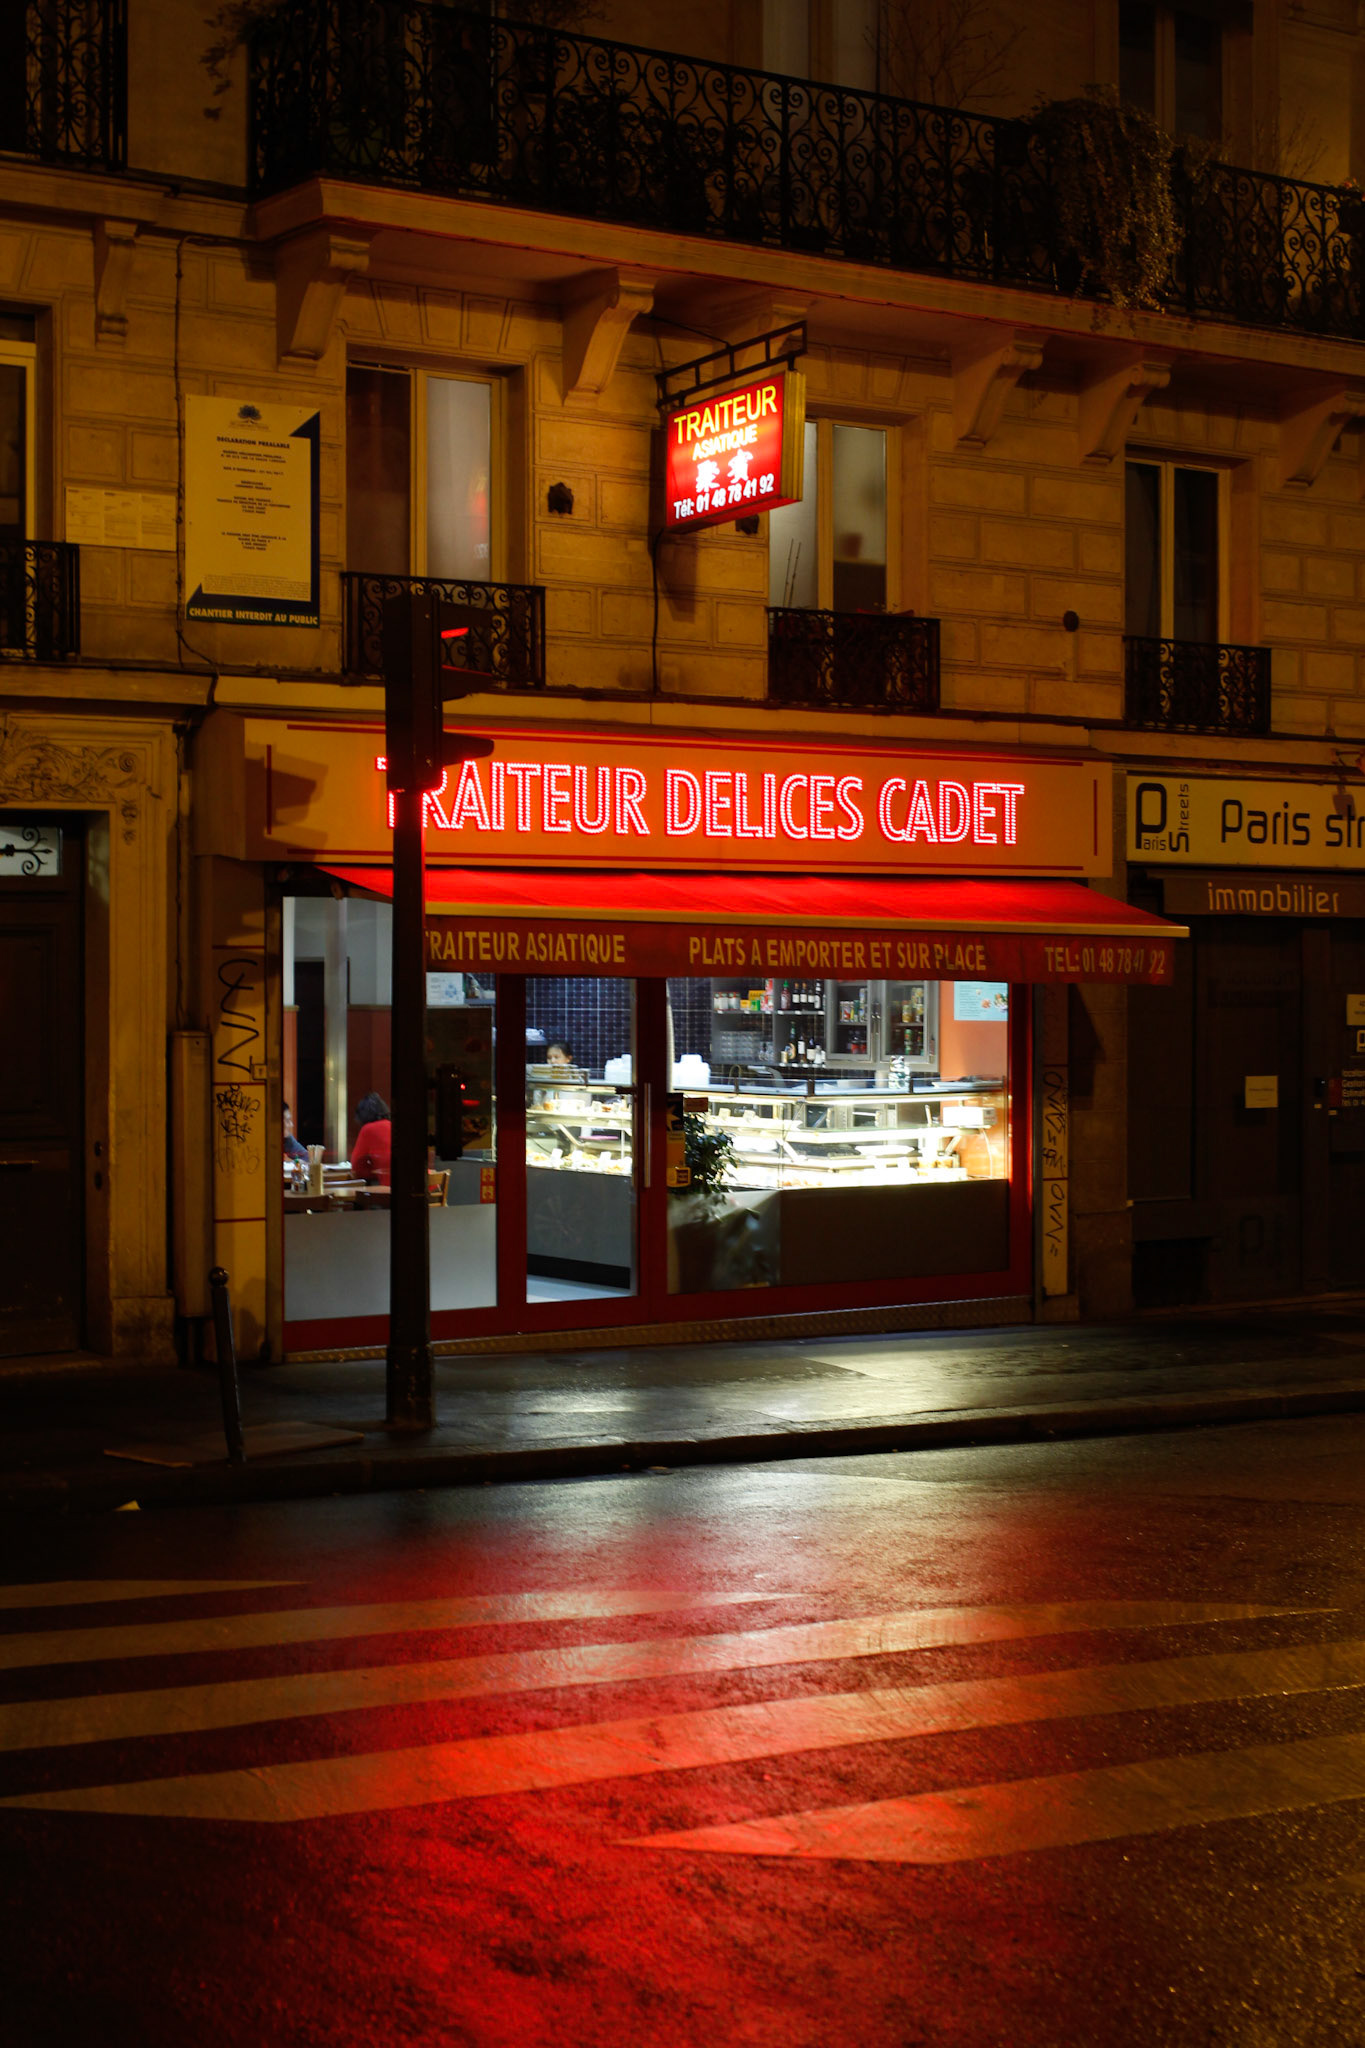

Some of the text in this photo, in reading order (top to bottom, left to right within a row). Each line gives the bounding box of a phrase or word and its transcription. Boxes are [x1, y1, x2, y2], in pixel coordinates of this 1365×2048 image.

[674, 385, 777, 444] TRAITEUR
[692, 423, 758, 461] ASIATIQUE
[696, 492, 710, 513] 01
[711, 487, 727, 508] 48
[728, 483, 742, 504] 78
[743, 478, 757, 499] 41
[759, 473, 775, 494] 92
[189, 607, 318, 625] CHANTIER INTERDIT AU PUBLIC
[665, 769, 865, 840] DELICES
[878, 777, 1025, 845] CADET
[1220, 799, 1311, 846] Paris
[1207, 881, 1340, 914] immobilier
[525, 932, 625, 963] ASIATIQUE
[689, 936, 987, 971] PLATS A EMPORTER ET SUR PLACE
[1044, 946, 1081, 973] TEL:
[1082, 947, 1096, 973] 01
[1099, 947, 1114, 973] 48
[1117, 948, 1132, 974] 78
